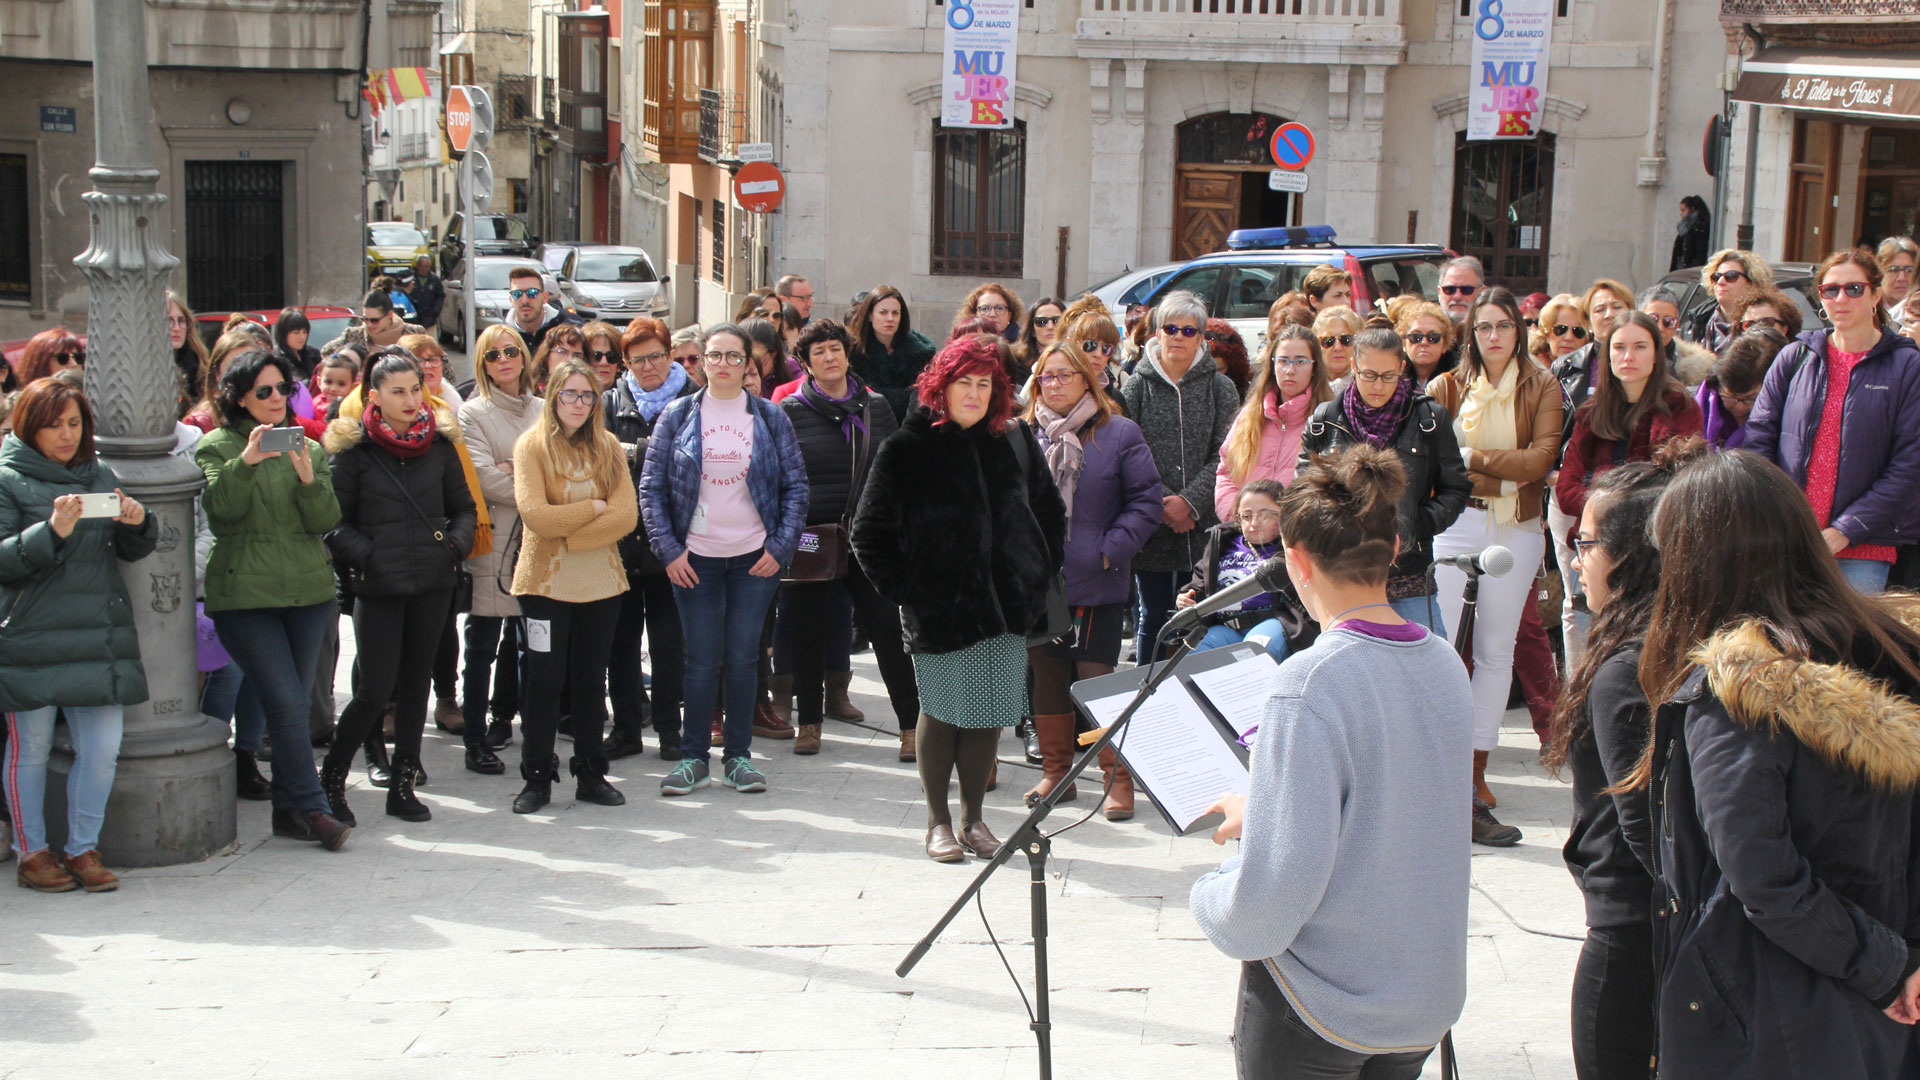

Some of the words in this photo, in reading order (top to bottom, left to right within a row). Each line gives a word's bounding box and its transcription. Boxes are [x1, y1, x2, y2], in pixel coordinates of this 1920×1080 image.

[947, 0, 974, 30] 8
[1475, 0, 1504, 41] 8
[953, 50, 1005, 75] MU
[1480, 61, 1536, 87] MU
[955, 74, 1009, 101] JER
[1482, 86, 1538, 112] JER
[1792, 79, 1809, 99] El
[1807, 78, 1833, 101] Taller
[450, 112, 470, 126] STOP
[701, 426, 716, 440] ORN
[733, 428, 751, 447] LOVE
[702, 448, 742, 460] Traveller
